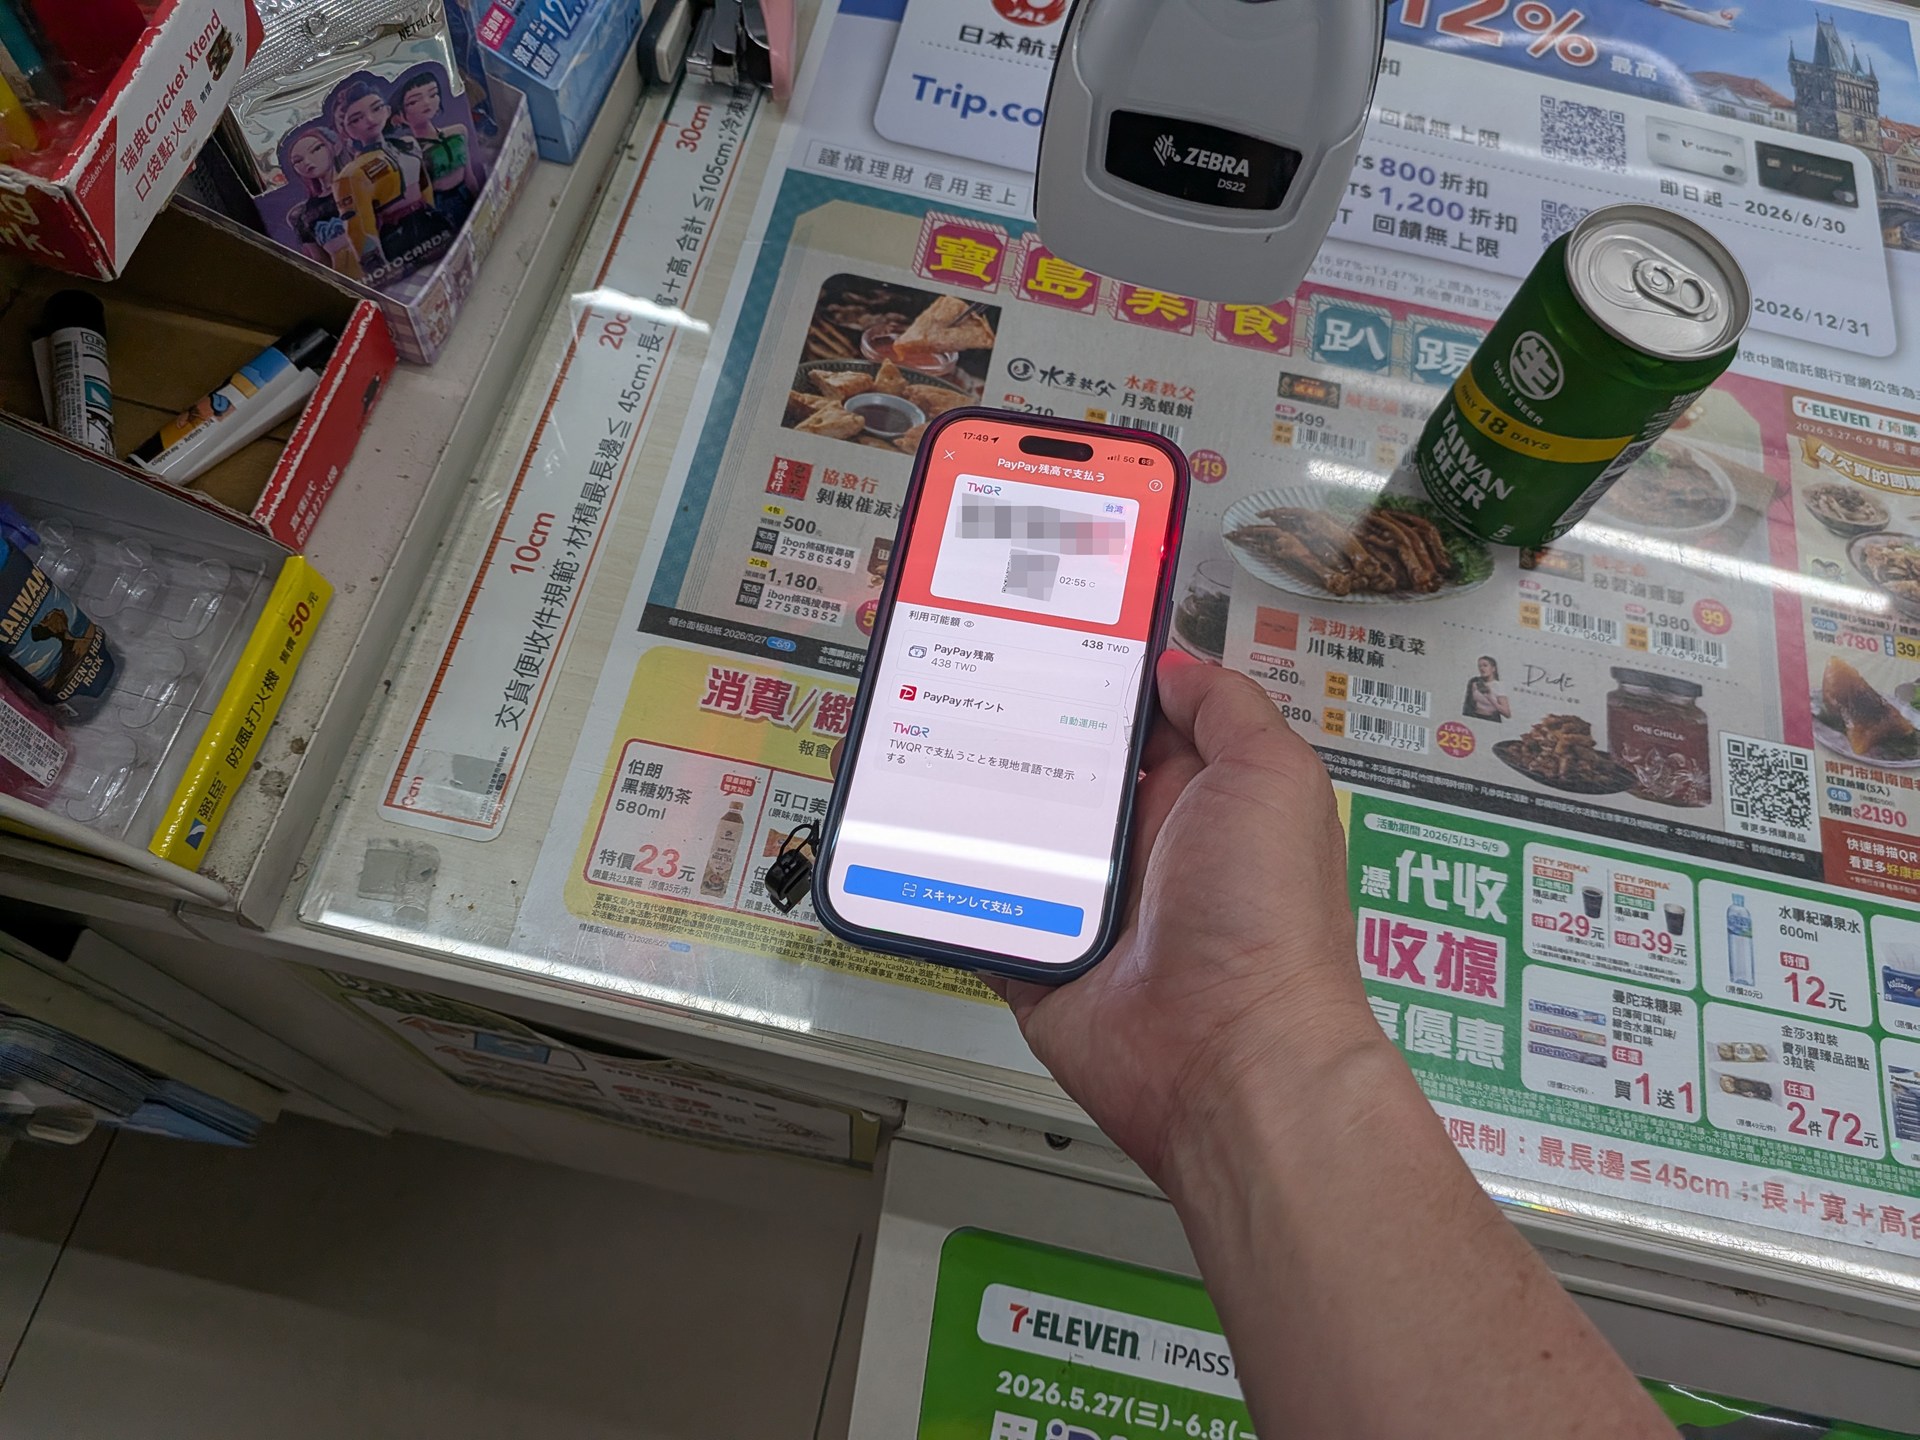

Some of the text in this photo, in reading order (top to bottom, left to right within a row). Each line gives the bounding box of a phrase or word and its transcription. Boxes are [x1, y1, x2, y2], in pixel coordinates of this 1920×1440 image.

[398, 12, 438, 42] NETFLIX
[1006, 7, 1049, 25] JAL
[184, 8, 223, 71] Xtend
[958, 25, 1059, 60] 日本航
[1609, 55, 1657, 81] 最高
[912, 74, 1043, 127] Trip.co
[676, 103, 713, 154] 30cm
[1380, 107, 1500, 150] 回饋無上限
[1184, 147, 1249, 178] ZEBRA
[79, 167, 106, 199] Swedish
[818, 148, 1017, 207] 謹慎理財 信用至上
[1217, 178, 1247, 193] DS22
[1380, 157, 1436, 187] 800
[1439, 171, 1488, 199] 折扣
[1350, 183, 1519, 235] T$ 1,200 折扣
[1660, 179, 1846, 234] 即日起 2026/6/30
[1372, 214, 1500, 259] 回饋無上限
[359, 229, 451, 286] HOTOCARDS
[600, 310, 632, 350] 20c
[1755, 298, 1870, 337] 2026/12/31
[1124, 375, 1196, 402] 水產教父
[1493, 360, 1543, 426] DRAFT BEER
[1121, 392, 1193, 420] 月亮蝦餅
[1461, 384, 1477, 410] ONLY
[1479, 407, 1509, 435] 18
[1510, 432, 1552, 451] DAYS
[1798, 401, 1871, 428] 7-ELEVEN
[1294, 411, 1326, 428] 499
[963, 431, 989, 443] 17:49
[1124, 455, 1135, 464] 5G
[1441, 407, 1515, 500] TAIWAN
[997, 458, 1106, 482] PayPay残高で支払う
[1191, 459, 1223, 476] 119
[1432, 436, 1487, 510] BEER
[822, 468, 879, 495] 協發行
[967, 482, 1002, 496] TWQR
[1105, 503, 1124, 515] 台湾
[783, 515, 816, 535] 500
[509, 512, 556, 575] 10cm
[780, 546, 853, 570] 27586549
[768, 568, 818, 591] 1,180
[1059, 575, 1087, 588] 02:55
[1541, 589, 1573, 608] 210
[8, 580, 50, 645] YEHLIU GEOPARK
[287, 601, 311, 638] 50
[764, 599, 838, 624] 27583852
[908, 610, 961, 628] 利用可能額
[1648, 612, 1690, 633] 1,980
[1700, 608, 1726, 627] 99
[934, 643, 995, 663] PayPay残高
[1081, 638, 1130, 655] 438 TWD
[1307, 637, 1385, 669] 川味椒麻
[58, 652, 95, 701] QUEEN'S
[83, 655, 105, 689] ROCK
[930, 657, 977, 674] 438 TWD
[1268, 667, 1300, 685] 260
[922, 690, 1005, 714] PayPayポイント
[1281, 704, 1312, 723] 880
[226, 669, 280, 769] 防風打火機
[893, 721, 930, 739] TWQR
[1059, 714, 1108, 732] 自動運用中
[1437, 730, 1473, 752] 235
[1632, 723, 1684, 741] ONE CHILLA
[627, 758, 664, 780] 伯朗
[886, 753, 906, 766] する
[620, 776, 693, 806] 黑糖奶茶
[615, 798, 667, 822] 580ml
[1376, 817, 1499, 853] 活動期間 2026/5/13~6/9
[1740, 821, 1807, 844] 看更多預購商品
[1846, 837, 1918, 862] 快速掃描QR
[1532, 856, 1588, 873] CITY PRIMA
[1614, 873, 1670, 891] CITY PRIMA
[923, 887, 1024, 917] スキャンして支払う
[1780, 924, 1819, 943] 600ml
[1363, 917, 1498, 999] 收據
[1534, 1001, 1579, 1019] mentos
[1612, 989, 1683, 1017] 曼陀珠糖果
[1533, 1023, 1578, 1040] mentos
[1612, 1030, 1654, 1047] 葡萄口味
[1781, 1025, 1839, 1047] 金莎3粒裝
[1533, 1044, 1580, 1060] mentos
[1783, 1056, 1815, 1072] 3粒裝
[1010, 1302, 1230, 1377] 7-ELEVEN iPASS
